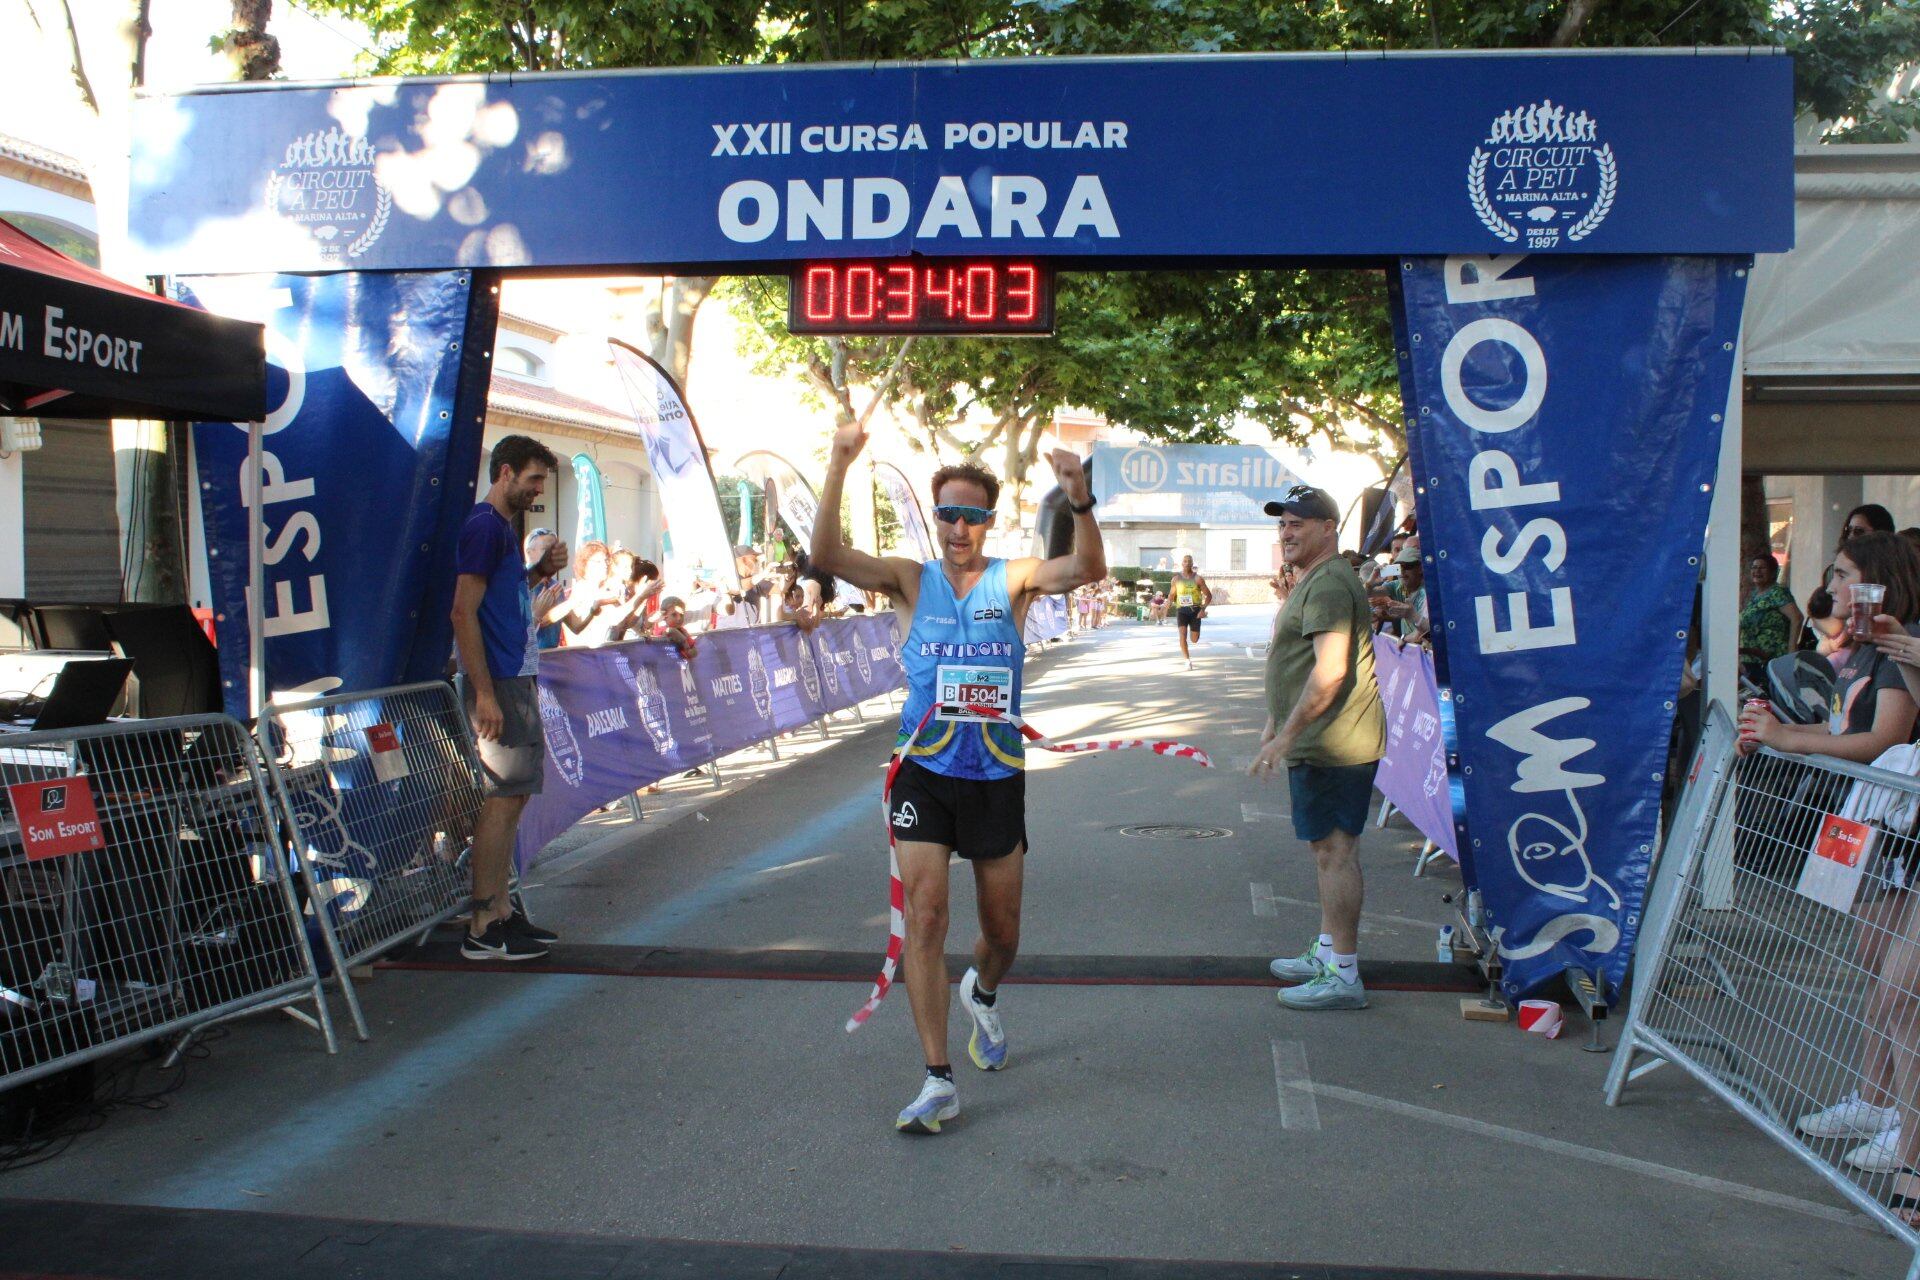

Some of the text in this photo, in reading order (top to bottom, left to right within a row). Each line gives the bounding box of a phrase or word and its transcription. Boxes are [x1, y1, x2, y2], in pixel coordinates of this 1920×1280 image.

[712, 121, 1129, 156] XXII CURSA POPULAR
[1494, 147, 1591, 168] CIRCUIT
[287, 170, 371, 190] CIRCUIT
[1496, 168, 1577, 190] A PEU
[288, 189, 358, 211] A PEU
[1504, 192, 1579, 203] MARINA ALTA
[295, 212, 359, 222] MARINA ALTA
[718, 175, 1121, 243] ONDARA
[1526, 228, 1559, 236] DES DE
[1528, 237, 1560, 248] 1997
[806, 266, 1035, 322] 00:34:03
[945, 687, 997, 703] B 1504
